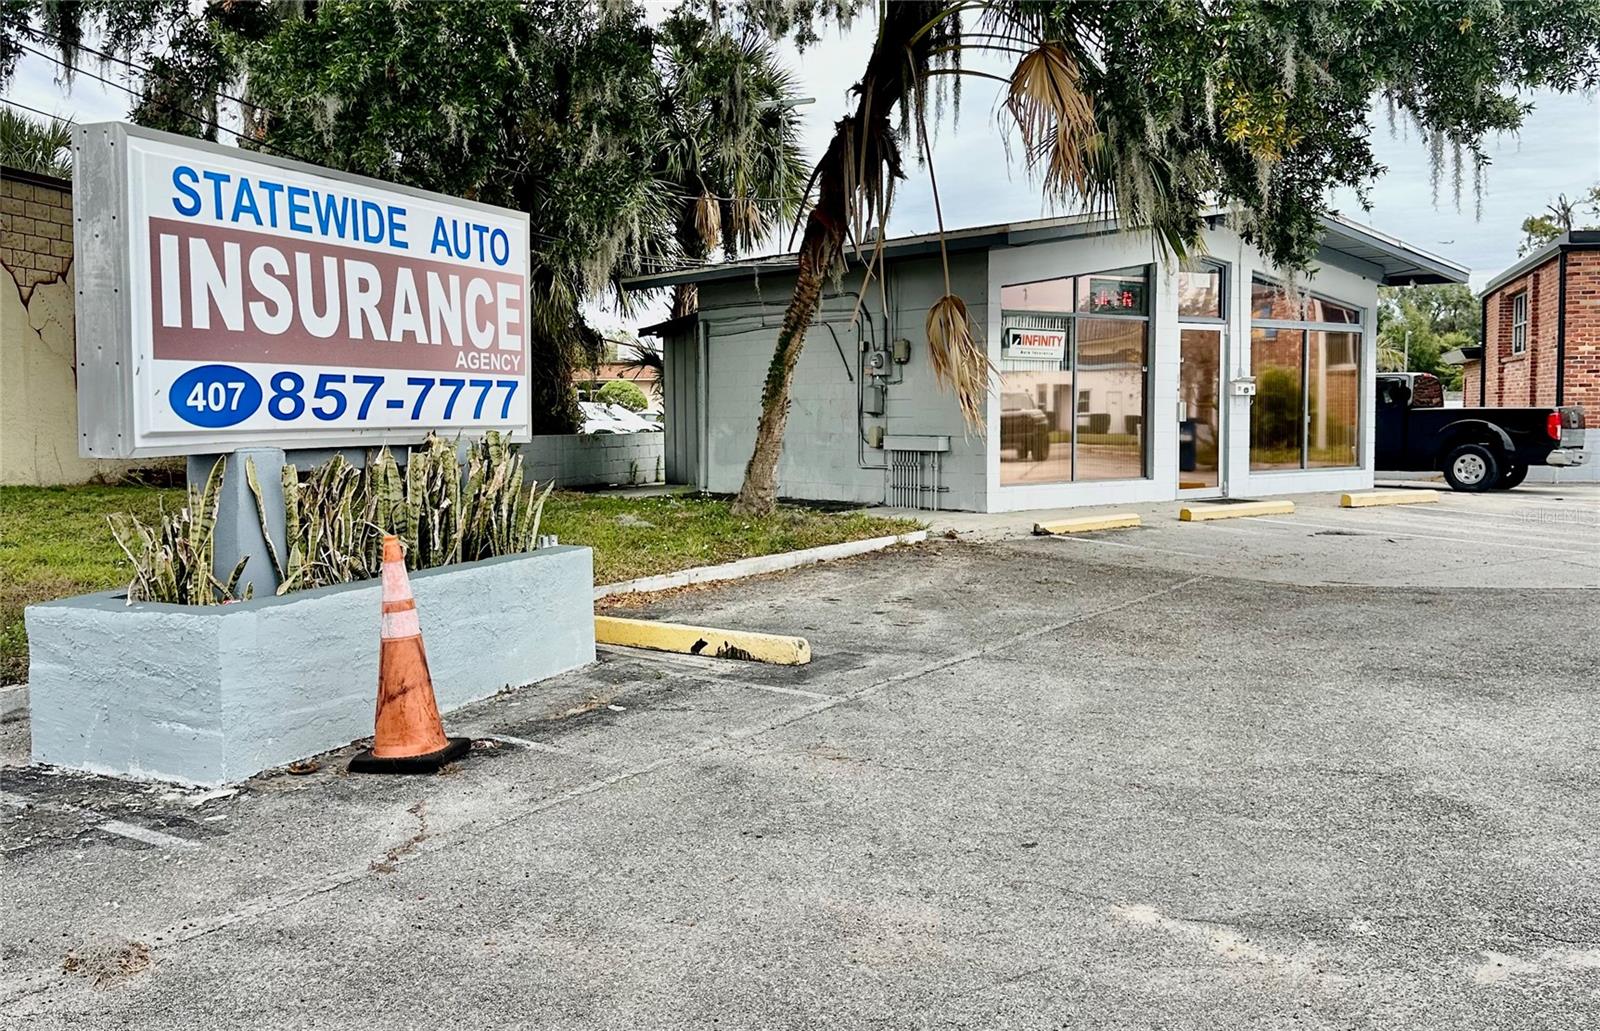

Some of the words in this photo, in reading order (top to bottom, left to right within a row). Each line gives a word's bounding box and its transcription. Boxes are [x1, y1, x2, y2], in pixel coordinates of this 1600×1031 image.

[172, 165, 409, 250] STATEWIDE
[430, 216, 510, 267] AUTO
[159, 232, 522, 352] INSURANCE
[455, 351, 521, 372] AGENCY
[1021, 334, 1063, 347] INFINITY
[186, 381, 246, 412] 407
[267, 371, 519, 422] 857-7777
